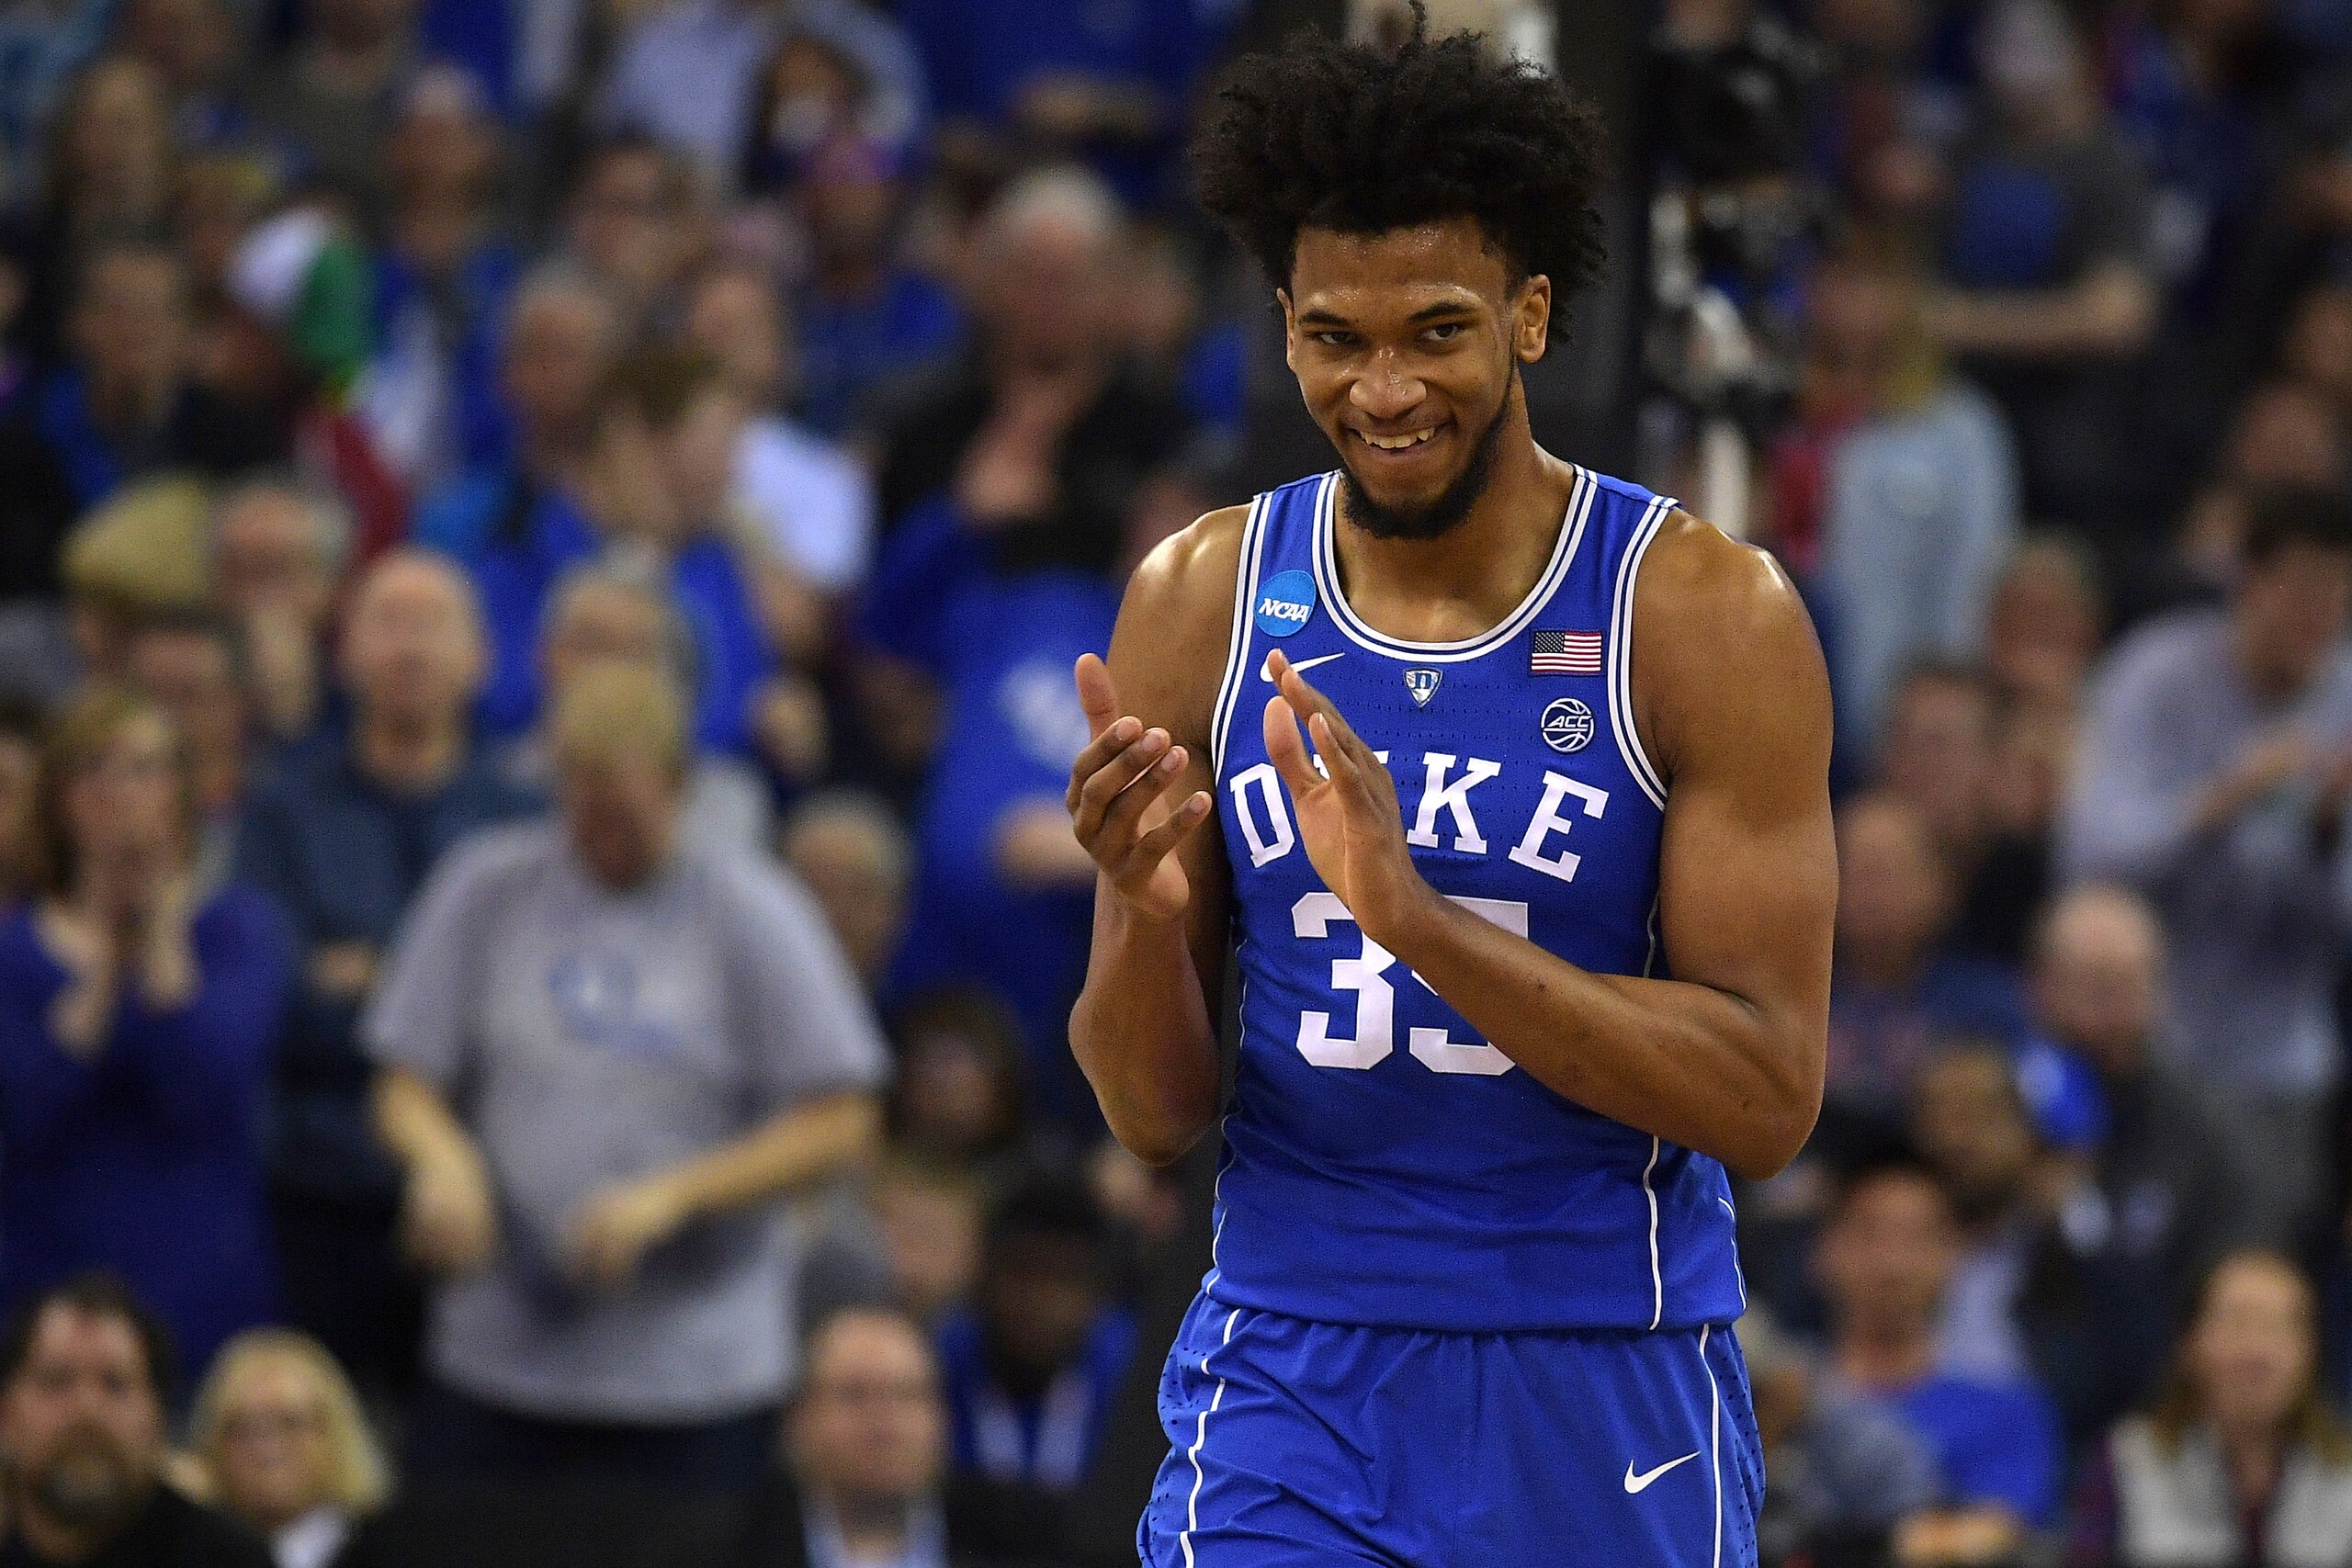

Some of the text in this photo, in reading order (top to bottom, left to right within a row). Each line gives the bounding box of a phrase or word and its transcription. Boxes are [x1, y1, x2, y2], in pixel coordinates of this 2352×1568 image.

[1259, 597, 1310, 623] NCAA
[1546, 715, 1592, 728] ACC
[1229, 750, 1610, 882] DKE
